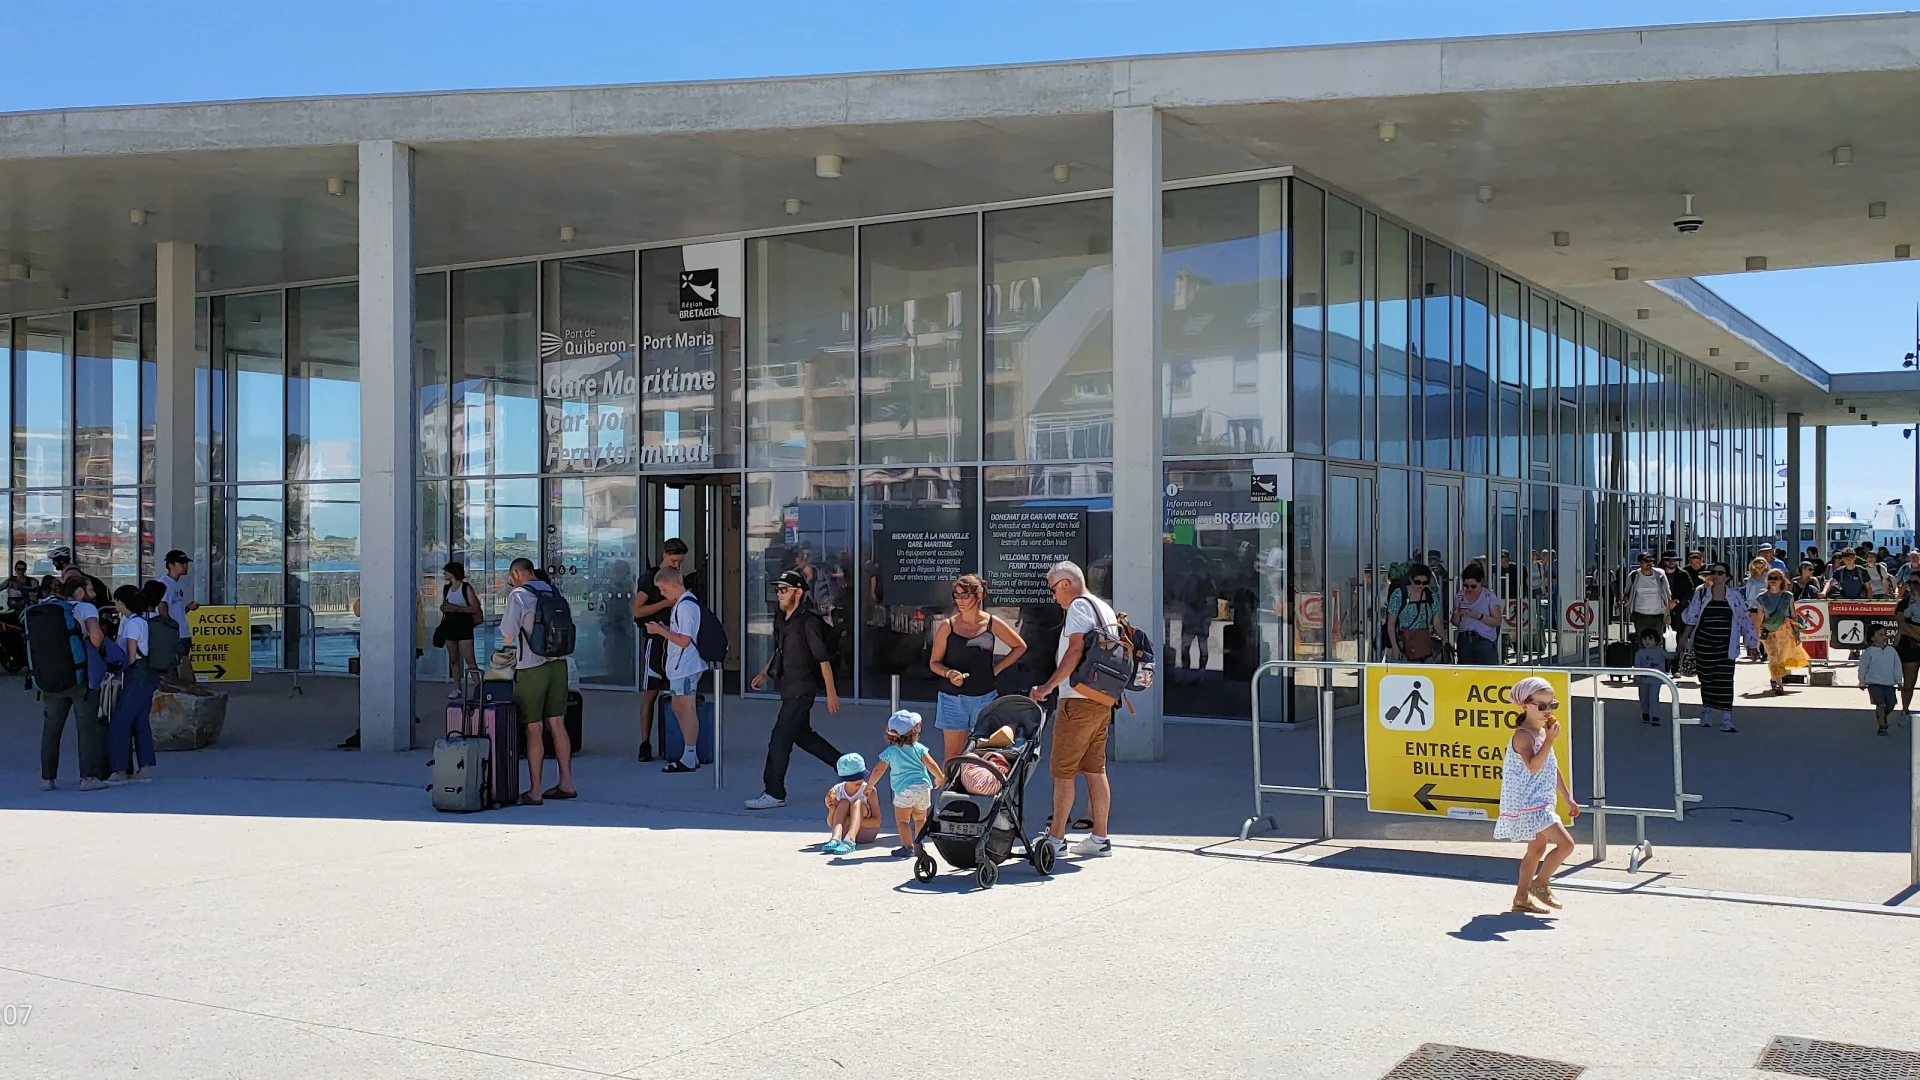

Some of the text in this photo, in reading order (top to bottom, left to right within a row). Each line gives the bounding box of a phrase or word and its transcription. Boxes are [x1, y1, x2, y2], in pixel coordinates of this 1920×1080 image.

[681, 301, 703, 309] Région
[680, 307, 720, 319] BRETAGNE
[565, 328, 595, 339] Port de
[565, 339, 626, 355] Quiberon
[643, 334, 672, 350] Port
[675, 331, 714, 348] Maria
[546, 367, 715, 398] Gare Maritime
[545, 410, 636, 434] Gar-vor
[546, 435, 710, 472] Ferry terminal
[1166, 500, 1212, 508] Informations
[1214, 511, 1280, 527] BREIZHGO
[891, 532, 924, 540] BIENVENUE
[924, 531, 929, 540] À
[938, 532, 970, 540] NOUVELLE
[991, 579, 1010, 587] Region
[1010, 579, 1018, 587] of
[1017, 579, 1040, 587] Brittany
[992, 596, 1000, 604] of
[999, 596, 1039, 604] transportation
[198, 614, 236, 624] ACCES
[192, 626, 243, 636] PIETONS
[204, 643, 230, 652] GARE
[190, 653, 227, 662] ETTERIE
[1466, 684, 1512, 704] ACC
[1454, 708, 1519, 729] PIETO
[1405, 741, 1507, 761] ENTRÉE GA
[1413, 761, 1503, 780] BILLETTER
